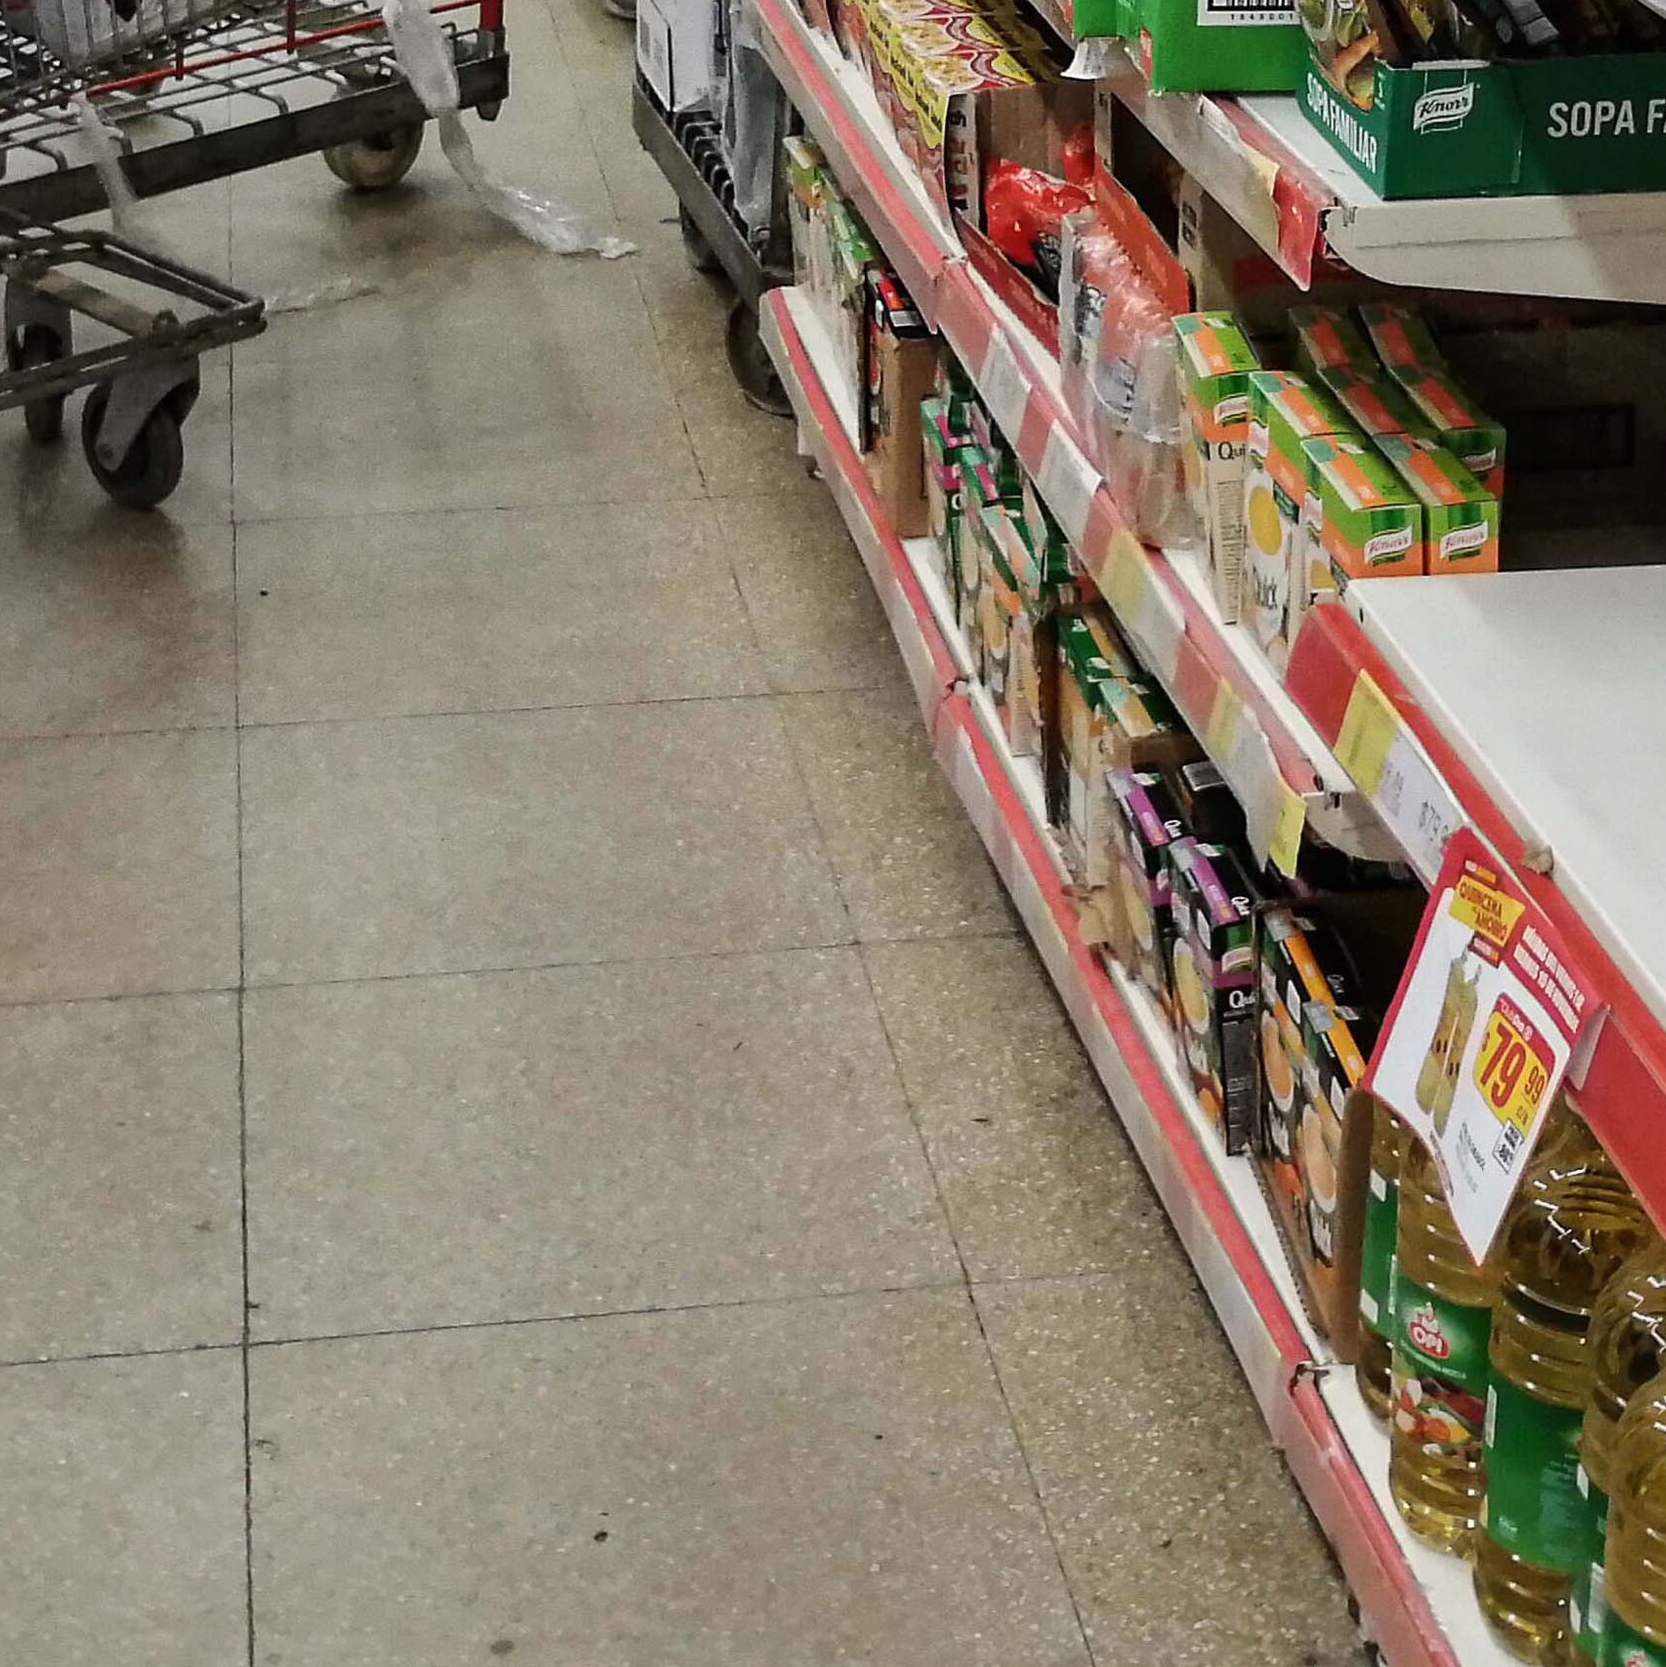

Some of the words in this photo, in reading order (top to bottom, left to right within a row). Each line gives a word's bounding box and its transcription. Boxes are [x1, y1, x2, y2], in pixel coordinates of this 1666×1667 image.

[1307, 72, 1330, 127] SOPA
[1330, 98, 1378, 174] FAMILIAR
[1419, 96, 1469, 118] Knorr
[1547, 100, 1635, 138] SOPA
[1413, 1325, 1443, 1353] OPI
